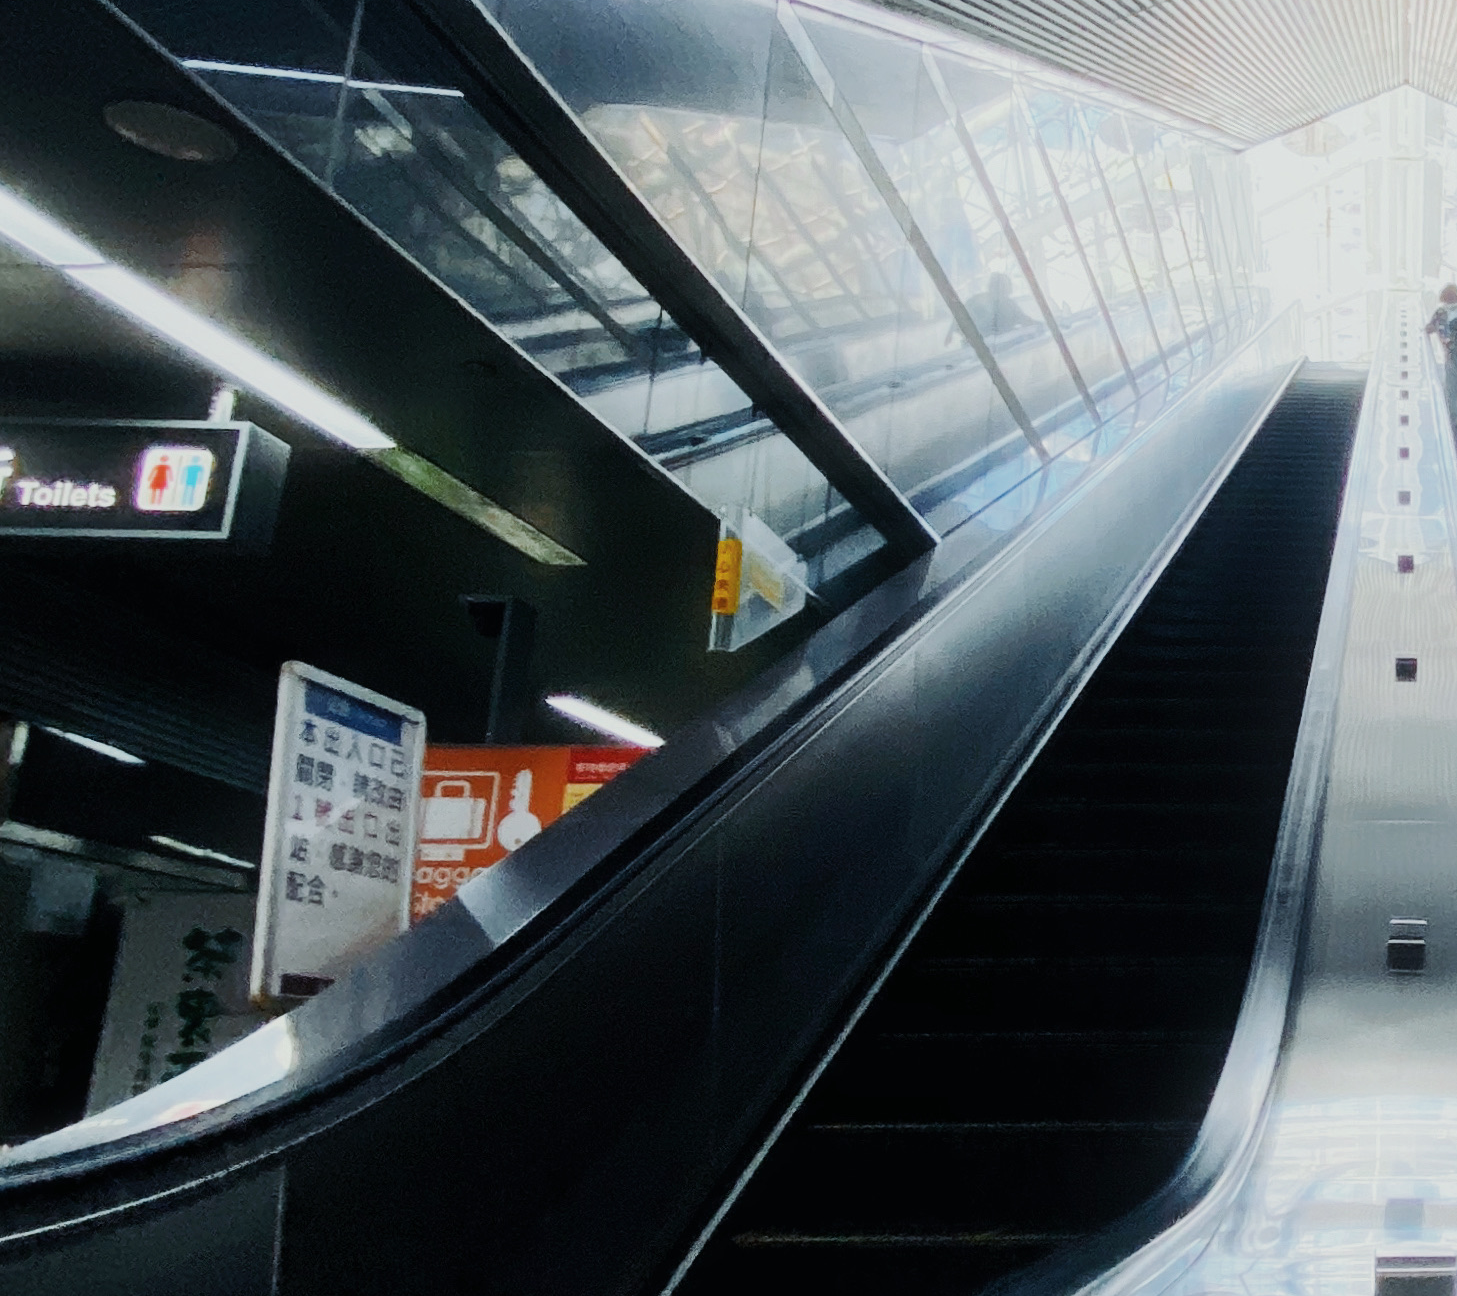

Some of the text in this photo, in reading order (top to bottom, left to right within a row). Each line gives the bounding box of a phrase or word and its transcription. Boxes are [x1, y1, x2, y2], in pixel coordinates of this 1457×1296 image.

[16, 479, 116, 508] Toilets
[300, 719, 405, 778] 本出入口已
